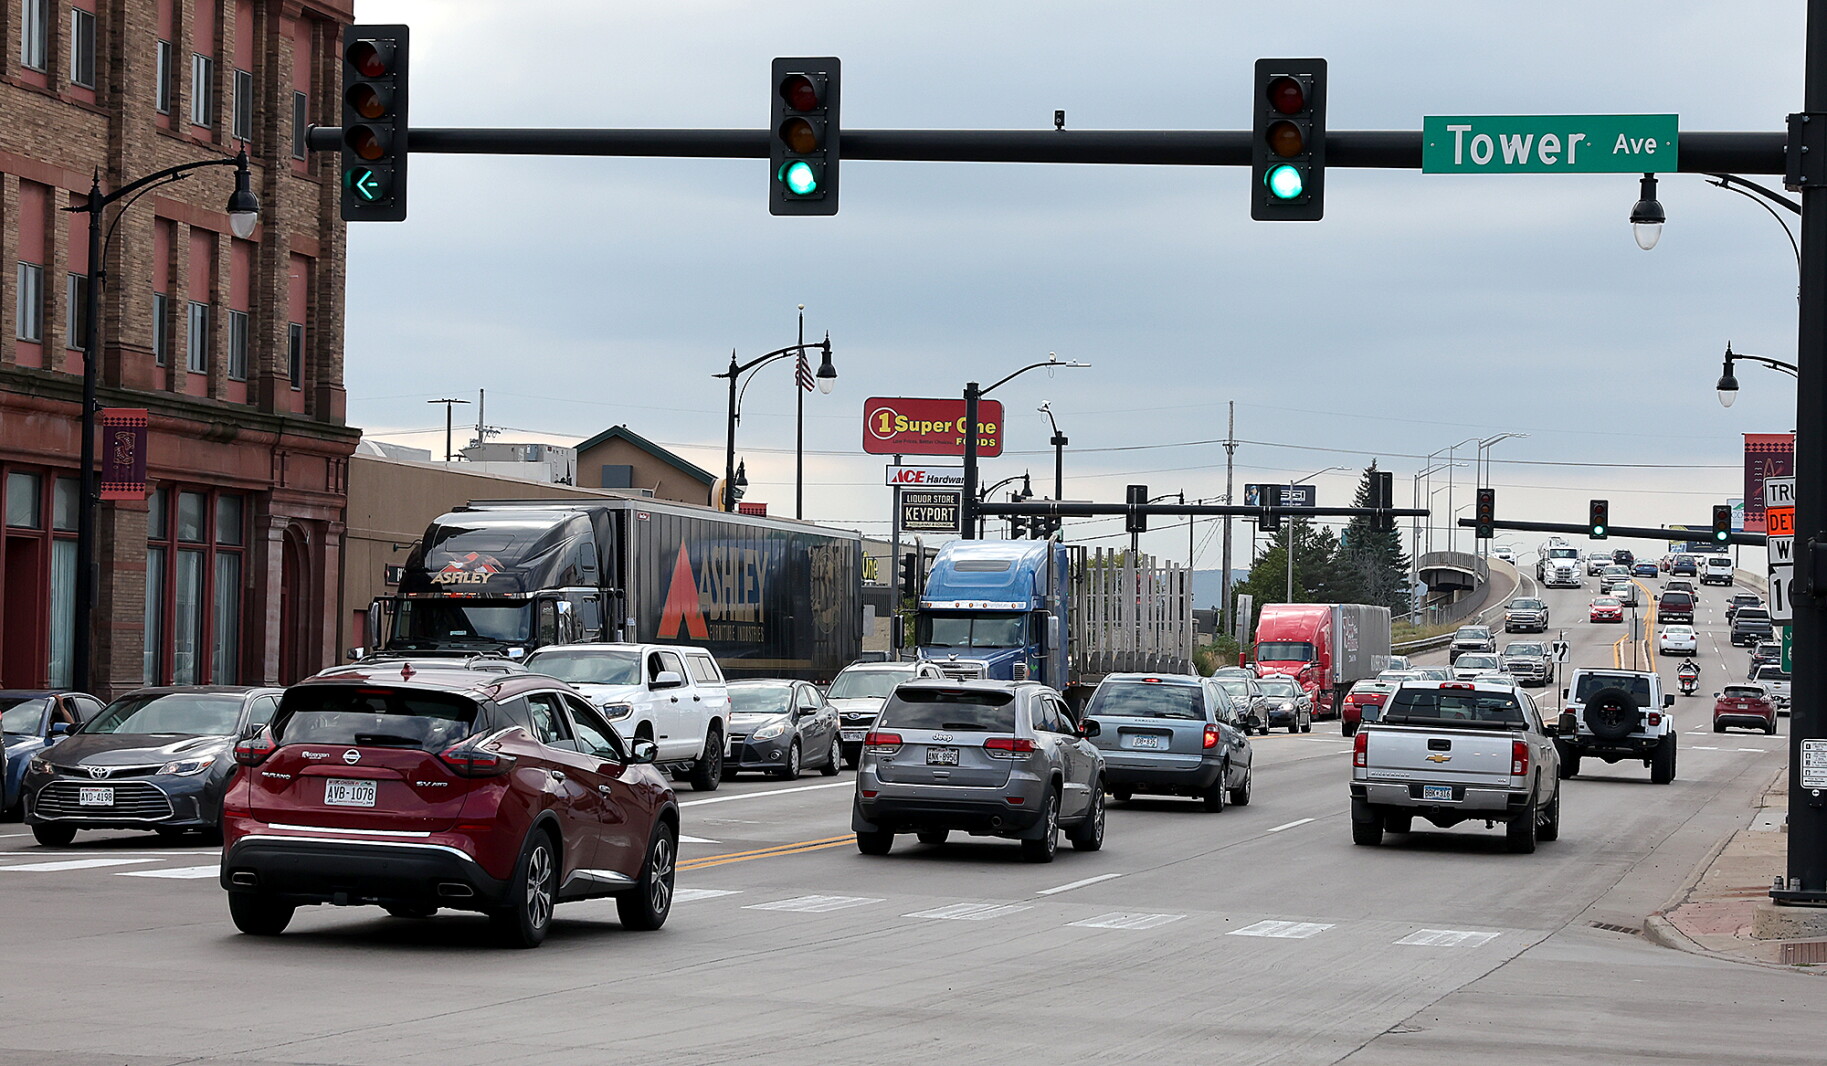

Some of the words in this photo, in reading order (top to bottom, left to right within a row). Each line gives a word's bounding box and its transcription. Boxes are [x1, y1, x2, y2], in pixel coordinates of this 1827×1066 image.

[1446, 124, 1586, 165] Tower
[1612, 133, 1657, 155] Ave
[879, 412, 891, 433] 1
[894, 415, 952, 436] Super
[956, 417, 997, 434] One
[891, 468, 926, 483] ACE
[926, 474, 965, 484] Hardwar
[906, 494, 932, 503] LIQUOR
[933, 495, 955, 503] STORE
[1769, 483, 1796, 501] TRU
[905, 506, 955, 522] KEYPORT
[1769, 513, 1795, 531] DET
[862, 551, 878, 579] One
[430, 572, 493, 585] ASHLEY
[698, 546, 769, 623] ASHLEY
[932, 733, 953, 742] Jeep
[327, 786, 374, 801] AVB-1078
